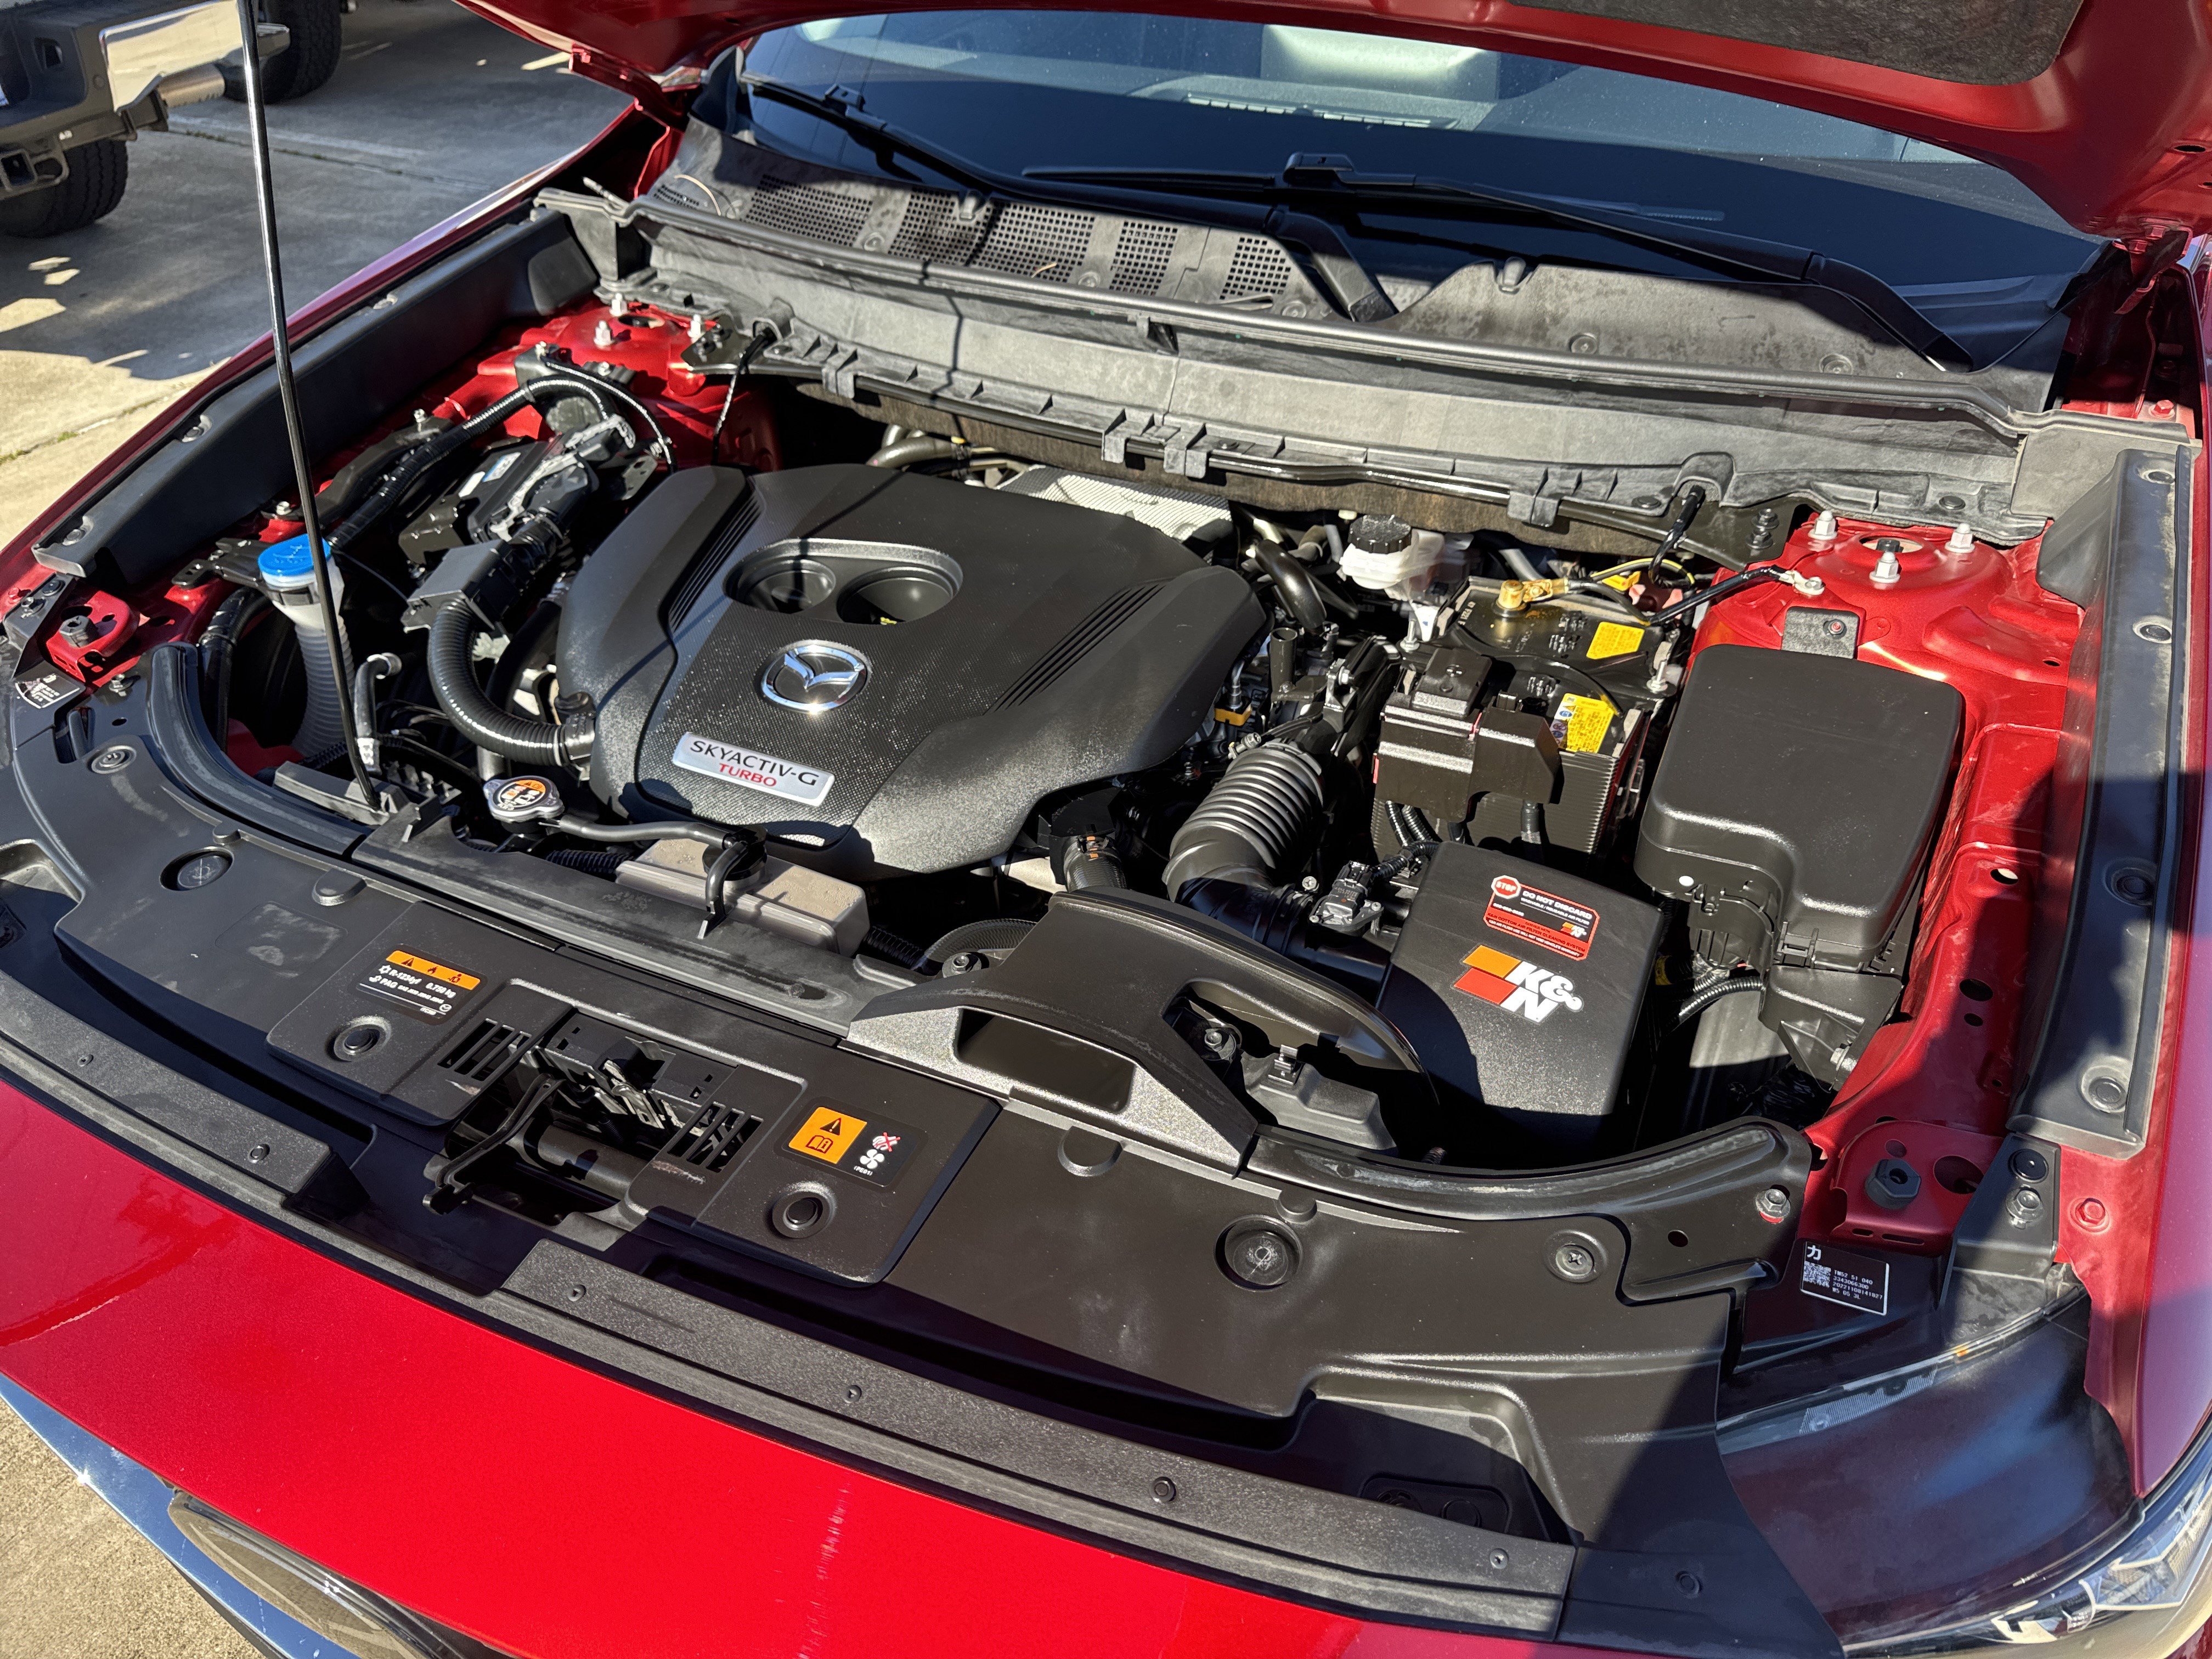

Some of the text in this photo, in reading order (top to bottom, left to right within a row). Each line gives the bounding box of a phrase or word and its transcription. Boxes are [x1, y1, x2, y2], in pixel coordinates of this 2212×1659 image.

[690, 741, 820, 786] SKYACTIV-G
[719, 763, 777, 787] TURBO
[1496, 881, 1516, 892] STOP
[1522, 890, 1593, 919] DO NOT DISCARD
[1575, 917, 1590, 925] FILTER
[1498, 916, 1517, 926] COTTON
[1526, 927, 1542, 935] FILTER
[1566, 942, 1585, 952] SYSTEM
[379, 978, 398, 989] PAG
[388, 969, 422, 984] R-1234yf
[444, 989, 456, 998] kg
[1500, 961, 1583, 1023] K&N
[854, 1165, 873, 1176] (PE01)
[1861, 1277, 1873, 1285] 040
